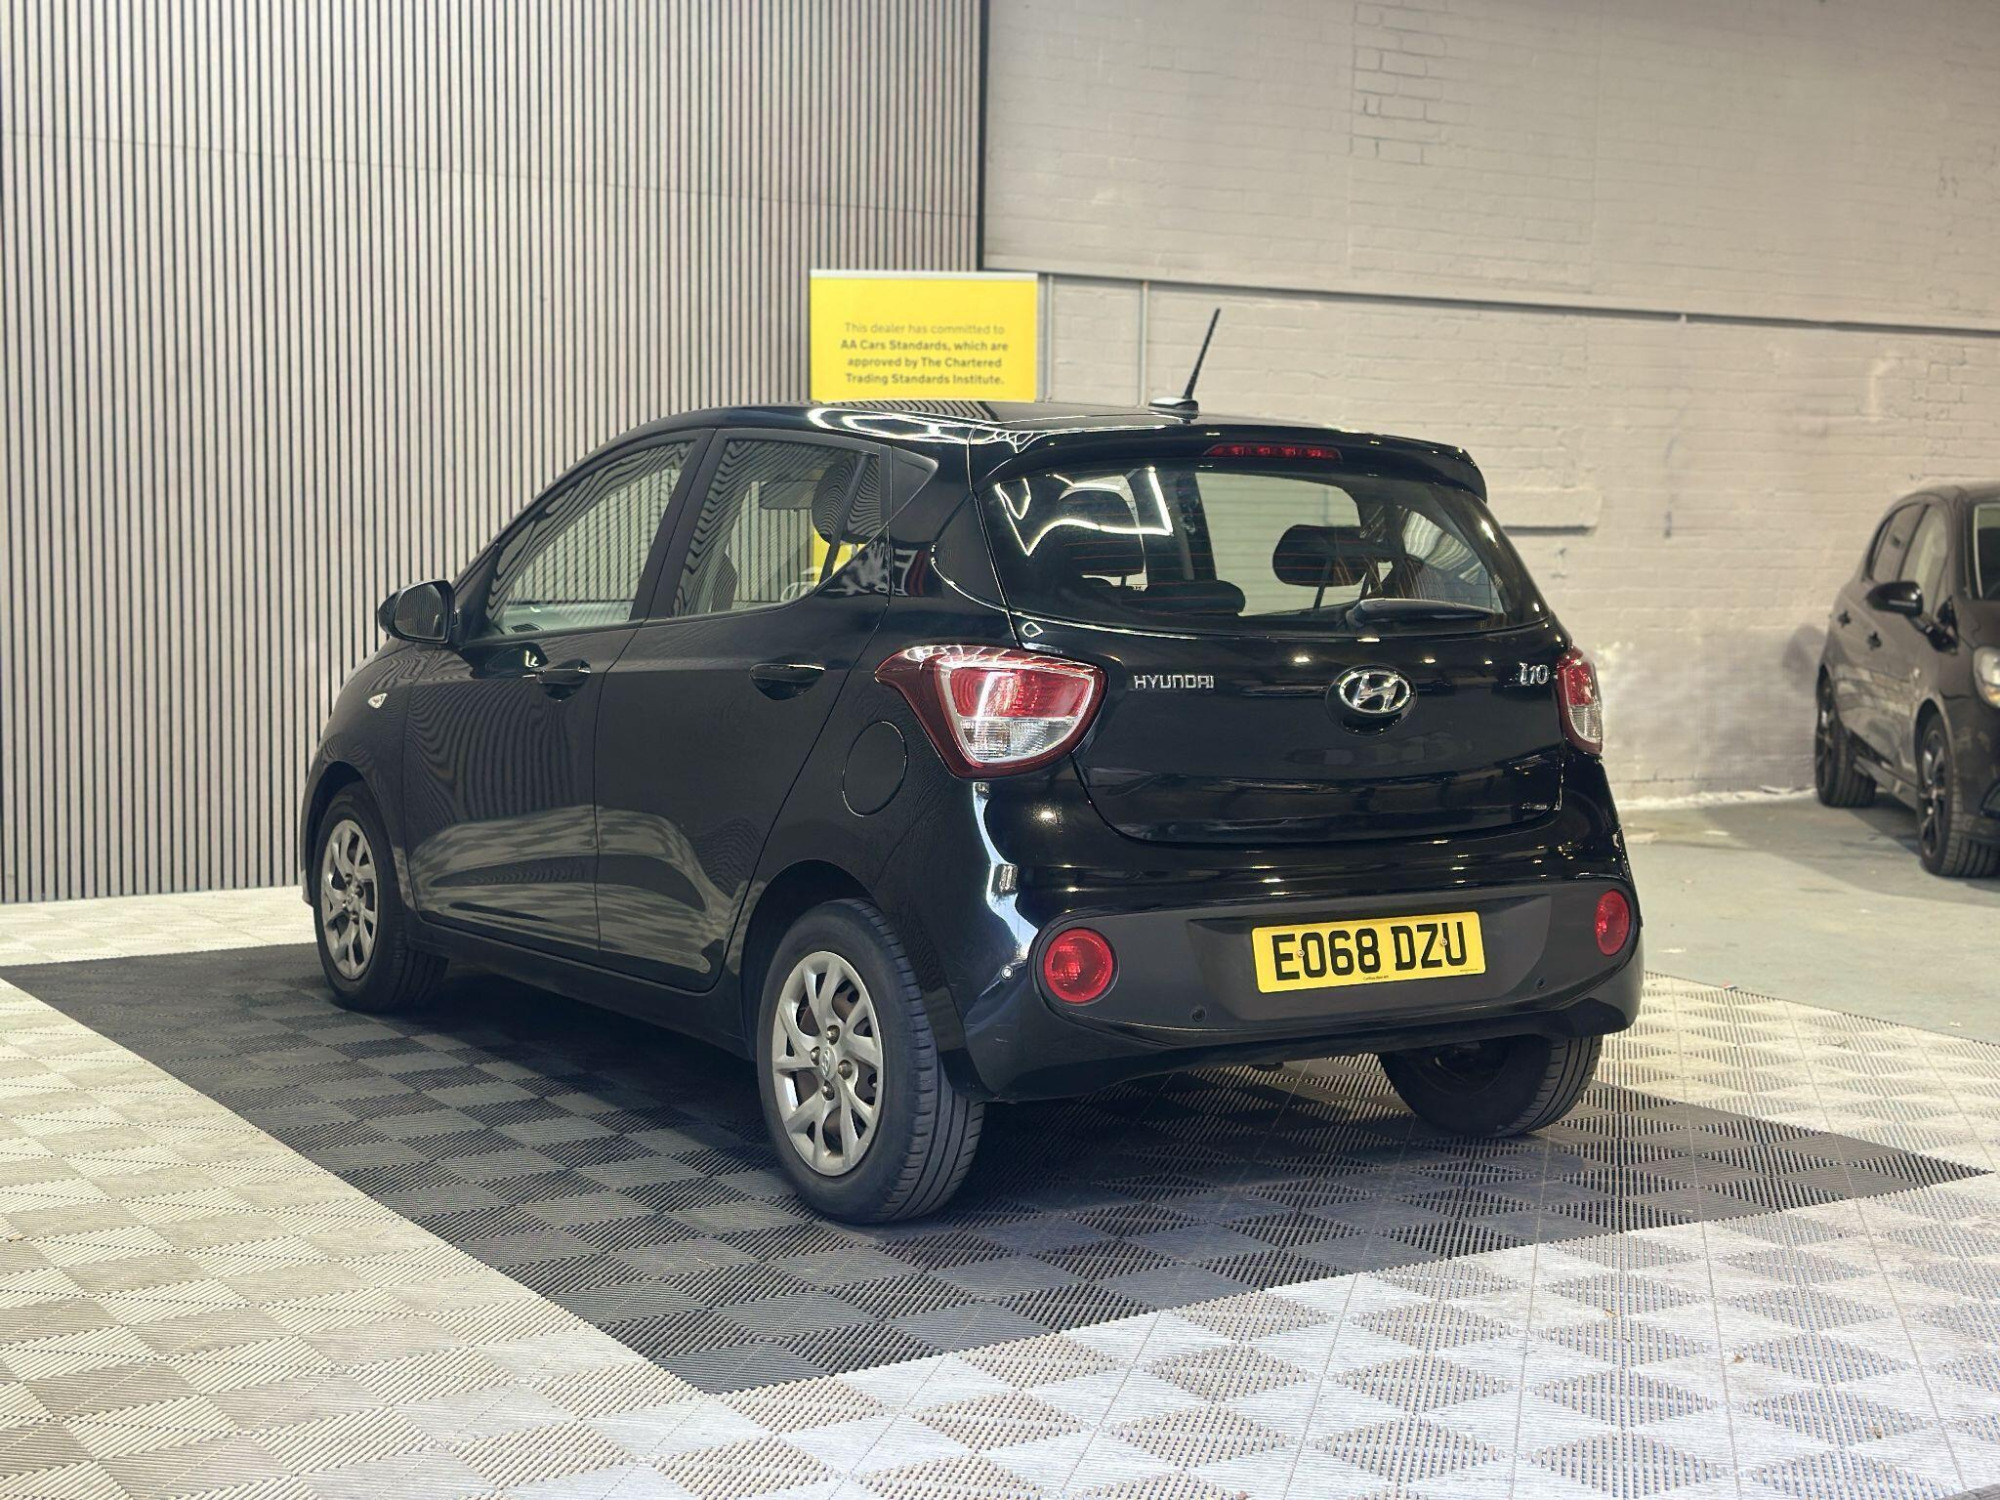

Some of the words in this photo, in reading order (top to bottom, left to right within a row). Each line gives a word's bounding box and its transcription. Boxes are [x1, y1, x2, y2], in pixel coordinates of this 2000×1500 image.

[845, 322, 868, 334] This
[870, 322, 905, 335] dealer
[908, 323, 928, 335] has
[930, 324, 989, 335] committed
[993, 325, 1005, 335] to
[840, 340, 857, 350] AA
[860, 340, 886, 350] Cars
[889, 340, 951, 352] Standards,
[954, 341, 988, 351] which
[990, 343, 1008, 352] are
[847, 357, 901, 369] approved
[905, 357, 917, 369] by
[921, 357, 942, 368] The
[944, 358, 1002, 369] Chartered
[846, 373, 889, 386] Trading
[891, 374, 950, 385] Standards
[953, 374, 1004, 386] Institute.
[1519, 662, 1550, 686] i10
[1134, 674, 1215, 690] HYUNDAI
[1390, 921, 1467, 972] DZU
